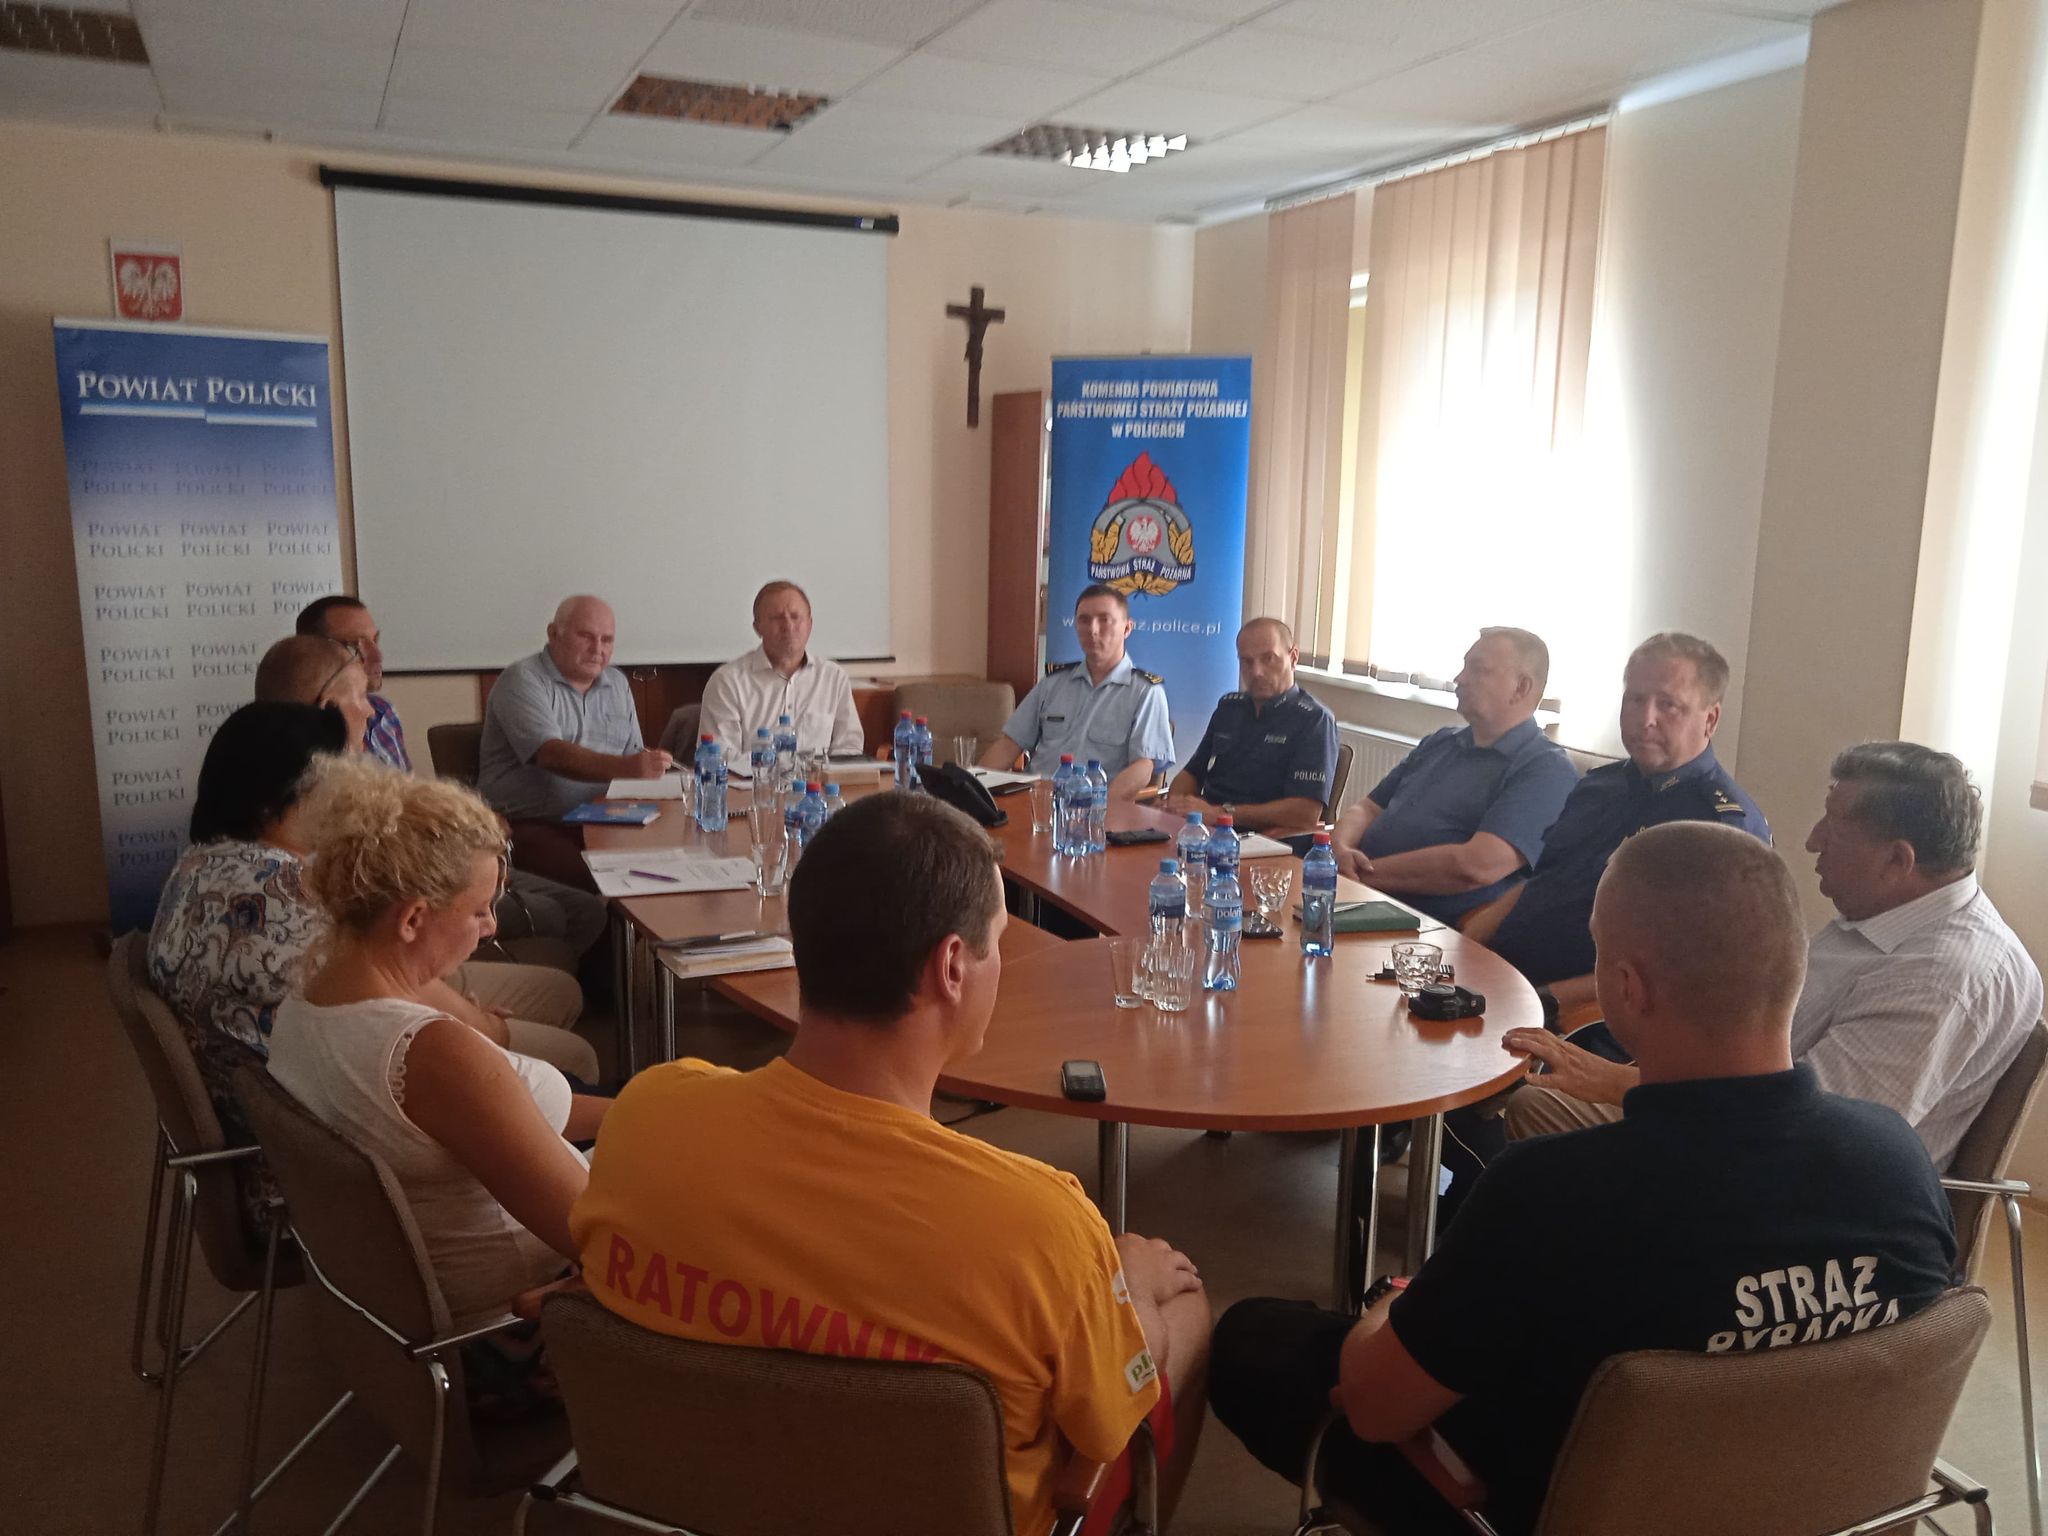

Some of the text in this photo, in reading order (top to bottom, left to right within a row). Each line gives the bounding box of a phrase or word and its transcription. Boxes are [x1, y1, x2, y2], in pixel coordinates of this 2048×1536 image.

[77, 370, 317, 408] POWIAT POLICKI
[1082, 379, 1218, 399] KOMENDA POWIATOWA
[1125, 421, 1185, 438] POLICACH
[88, 521, 329, 538] POWIAT POWIAT POWIAT
[89, 541, 332, 559] POLICKI POLICKI POLICKI
[93, 581, 334, 601] POWIAT POWIAT POWIAT
[95, 605, 168, 622] POLICKI
[186, 602, 256, 618] POLICKI
[99, 641, 257, 664] POWIAT POWIAT
[101, 663, 258, 685] POLICKI POLICK
[106, 707, 178, 725] POWIAT
[107, 727, 180, 746] POLICKI
[112, 768, 184, 786] POWIAT
[1294, 770, 1326, 784] POLICJA
[113, 787, 185, 806] POLICKI
